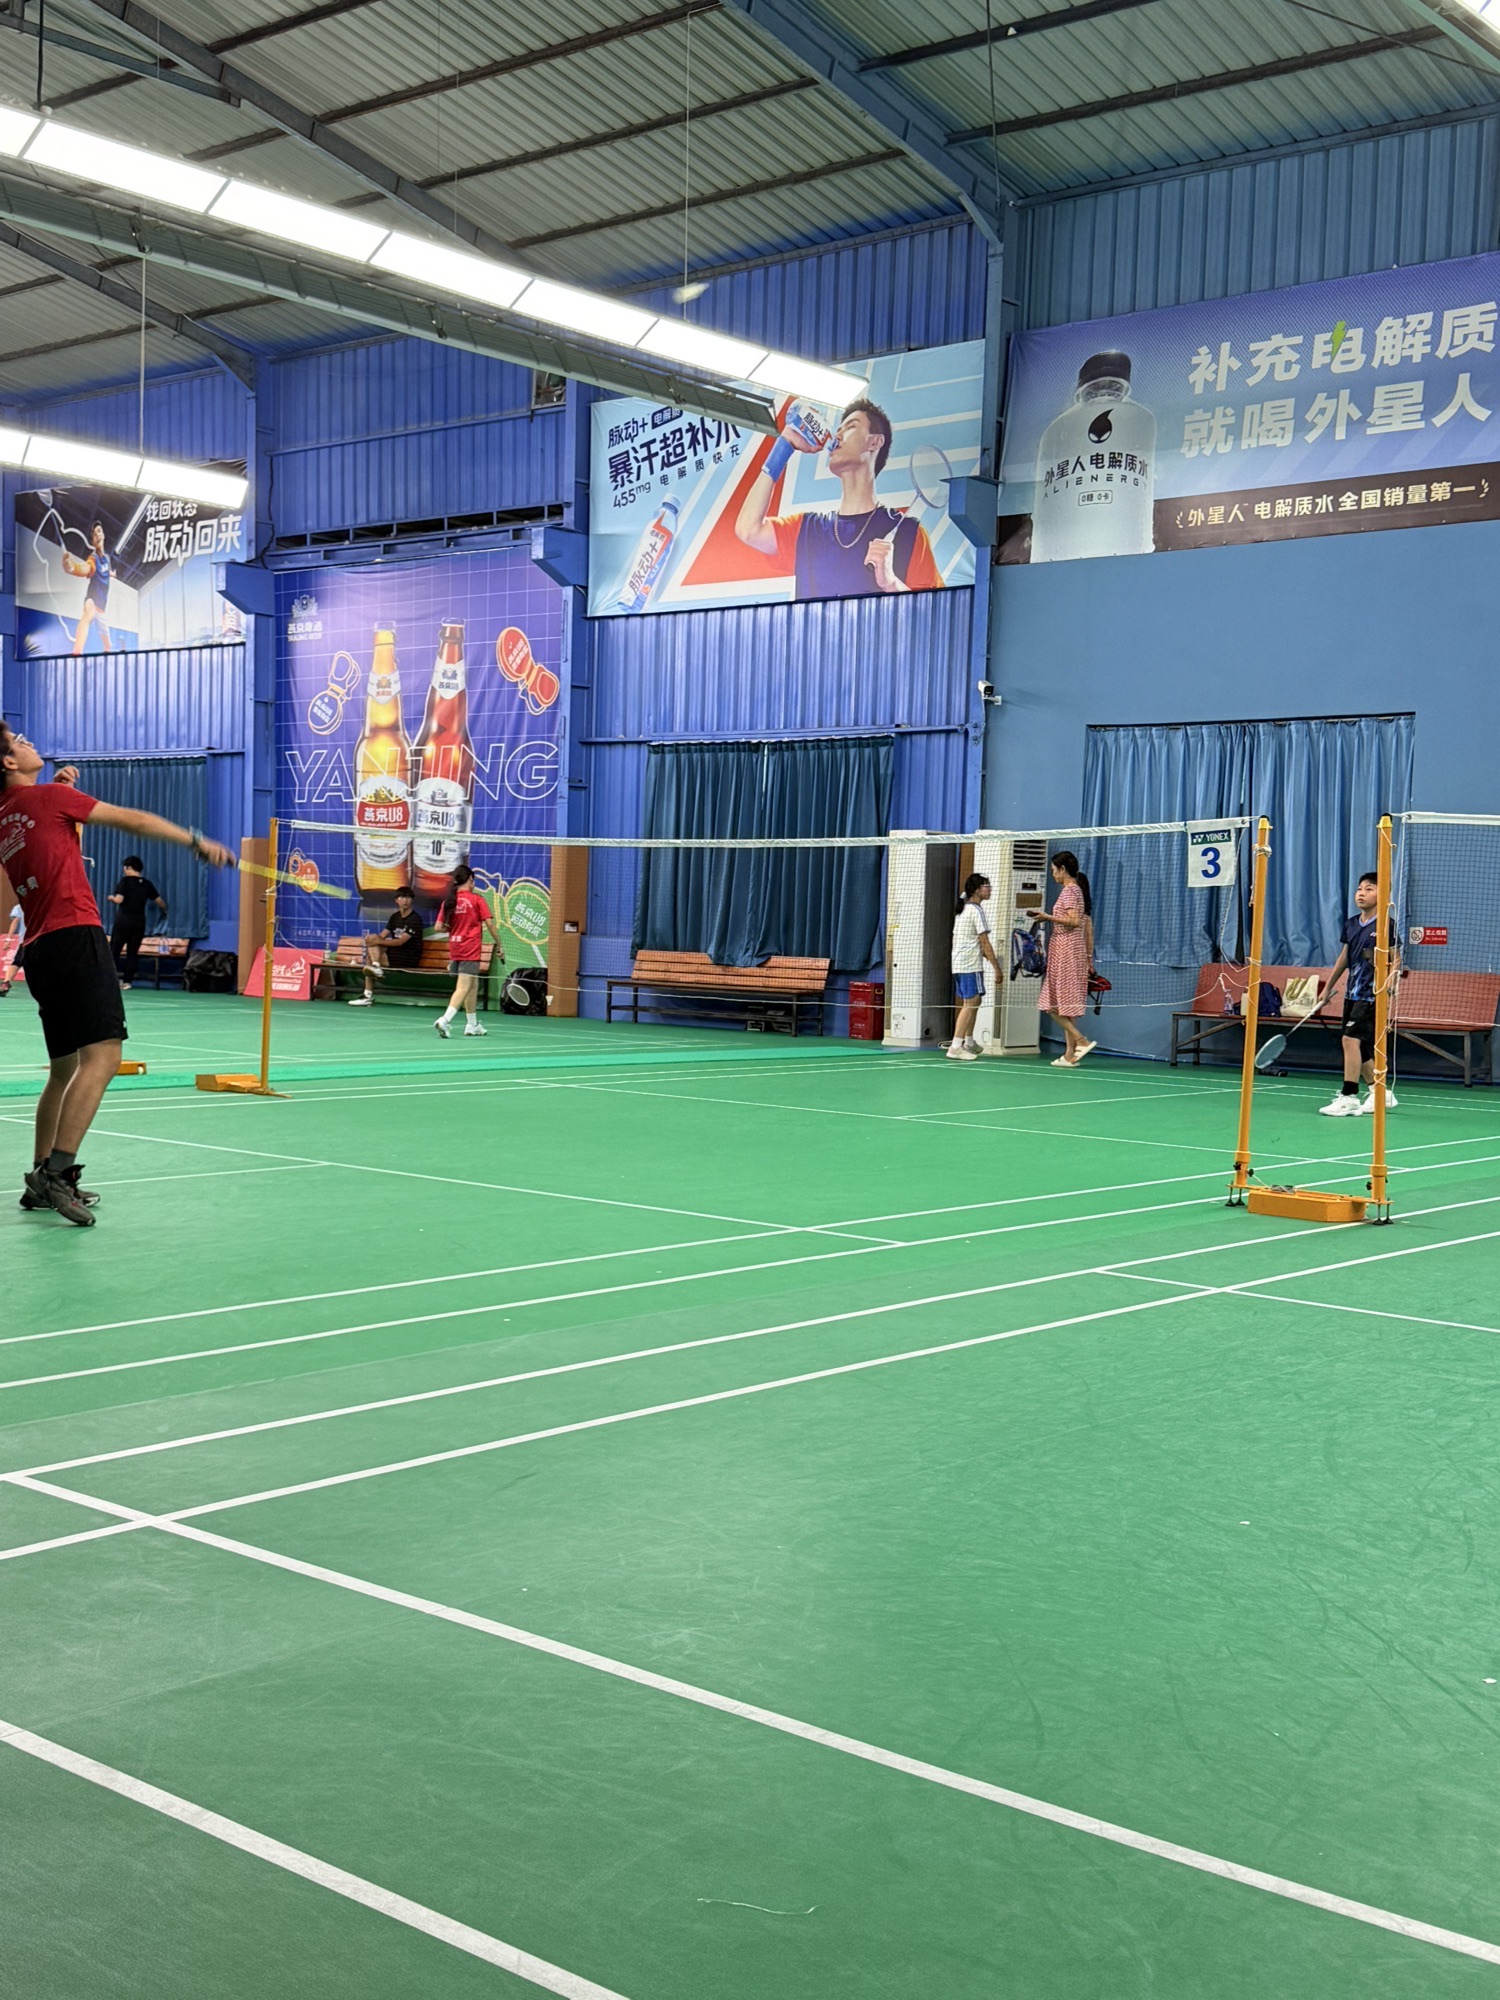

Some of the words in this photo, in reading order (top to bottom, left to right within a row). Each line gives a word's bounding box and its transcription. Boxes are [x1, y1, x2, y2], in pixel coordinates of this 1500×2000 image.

[1188, 301, 1498, 394] 补充电解质
[1180, 372, 1493, 458] 就喝外星人
[608, 416, 741, 491] 暴汗超补水
[613, 482, 651, 508] 455mg
[660, 444, 741, 486] 电解质快充
[1044, 451, 1148, 487] 外星人电解质水
[146, 500, 198, 522] 找回状态
[142, 514, 242, 568] 脉动回来
[285, 740, 560, 803] YANJING
[364, 806, 403, 822] 燕京U8
[1206, 832, 1229, 842] YONEX
[1201, 847, 1221, 878] 3
